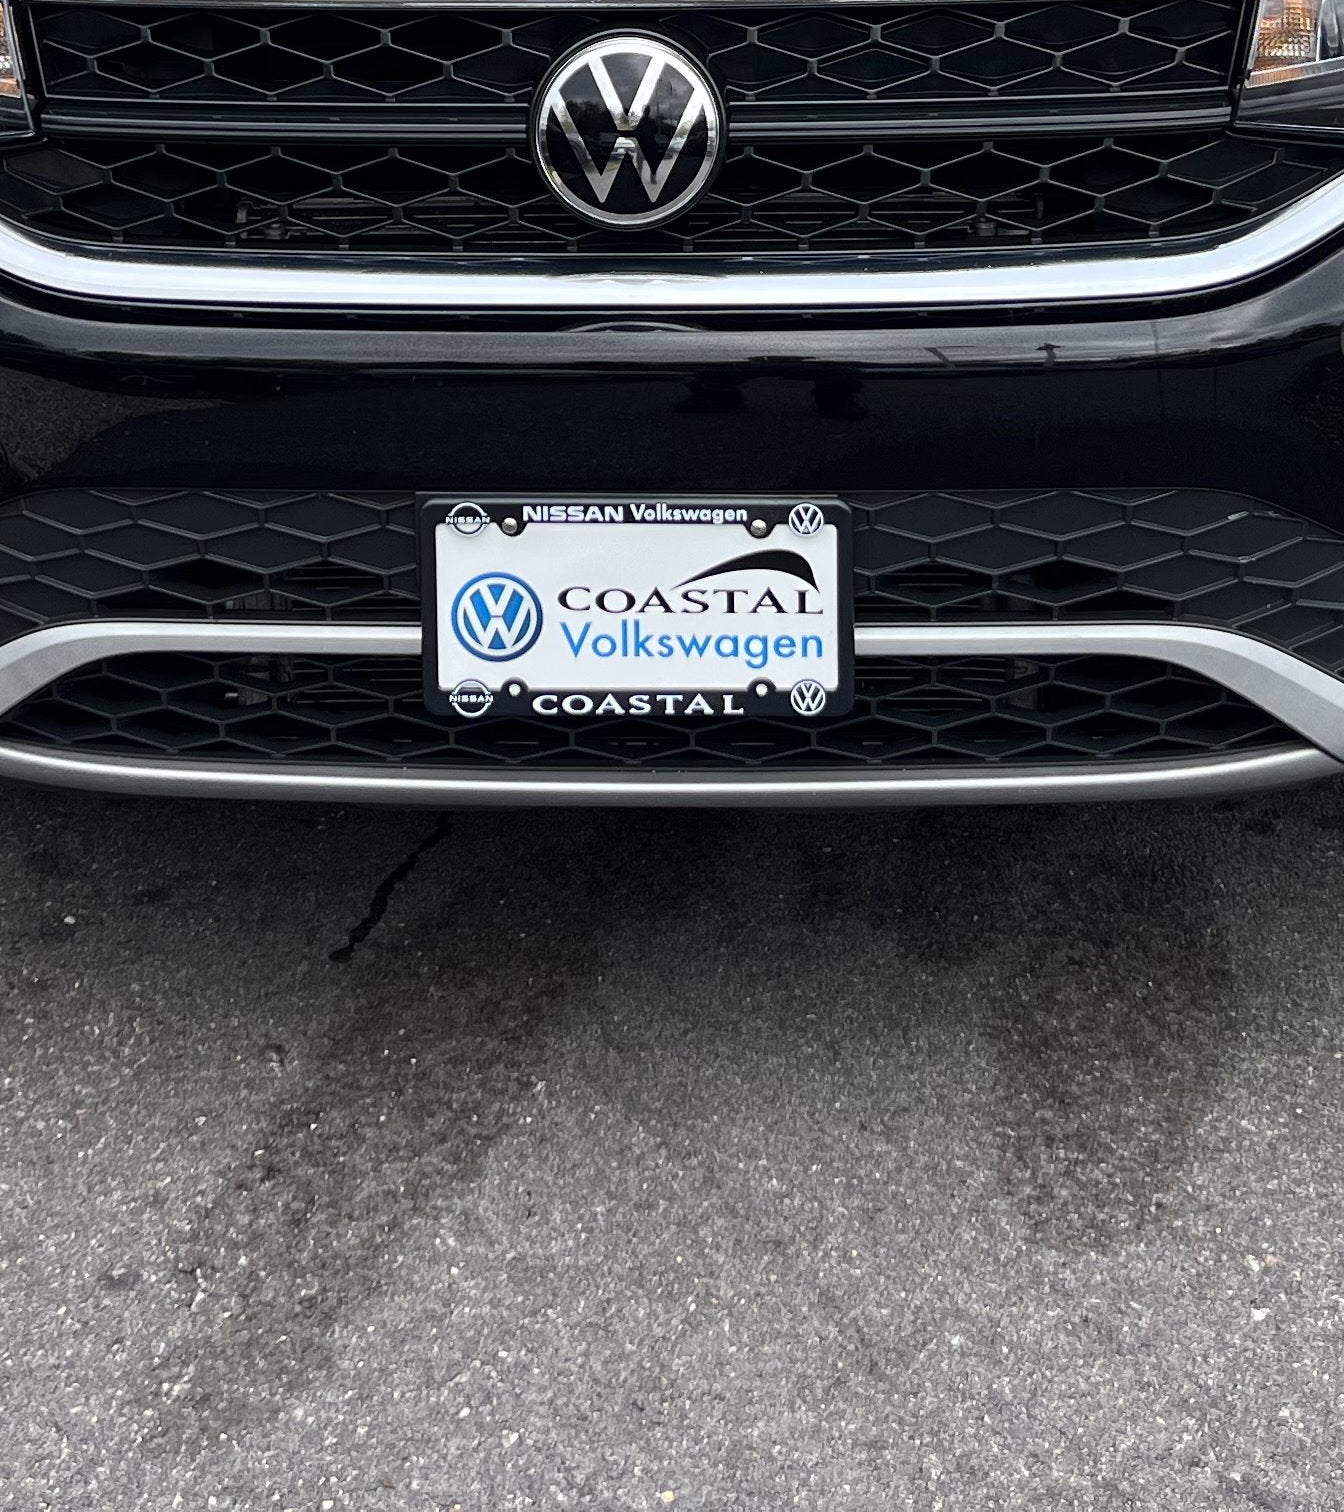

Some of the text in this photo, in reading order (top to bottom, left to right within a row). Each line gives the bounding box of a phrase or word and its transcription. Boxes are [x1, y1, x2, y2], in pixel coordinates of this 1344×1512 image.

[445, 516, 490, 524] NISSAN
[522, 503, 748, 525] NISSAN Volkswagen
[557, 586, 824, 615] COASTAL
[559, 618, 823, 669] Volkswagen
[449, 694, 494, 703] NISSAN
[532, 694, 745, 715] COASTAL
